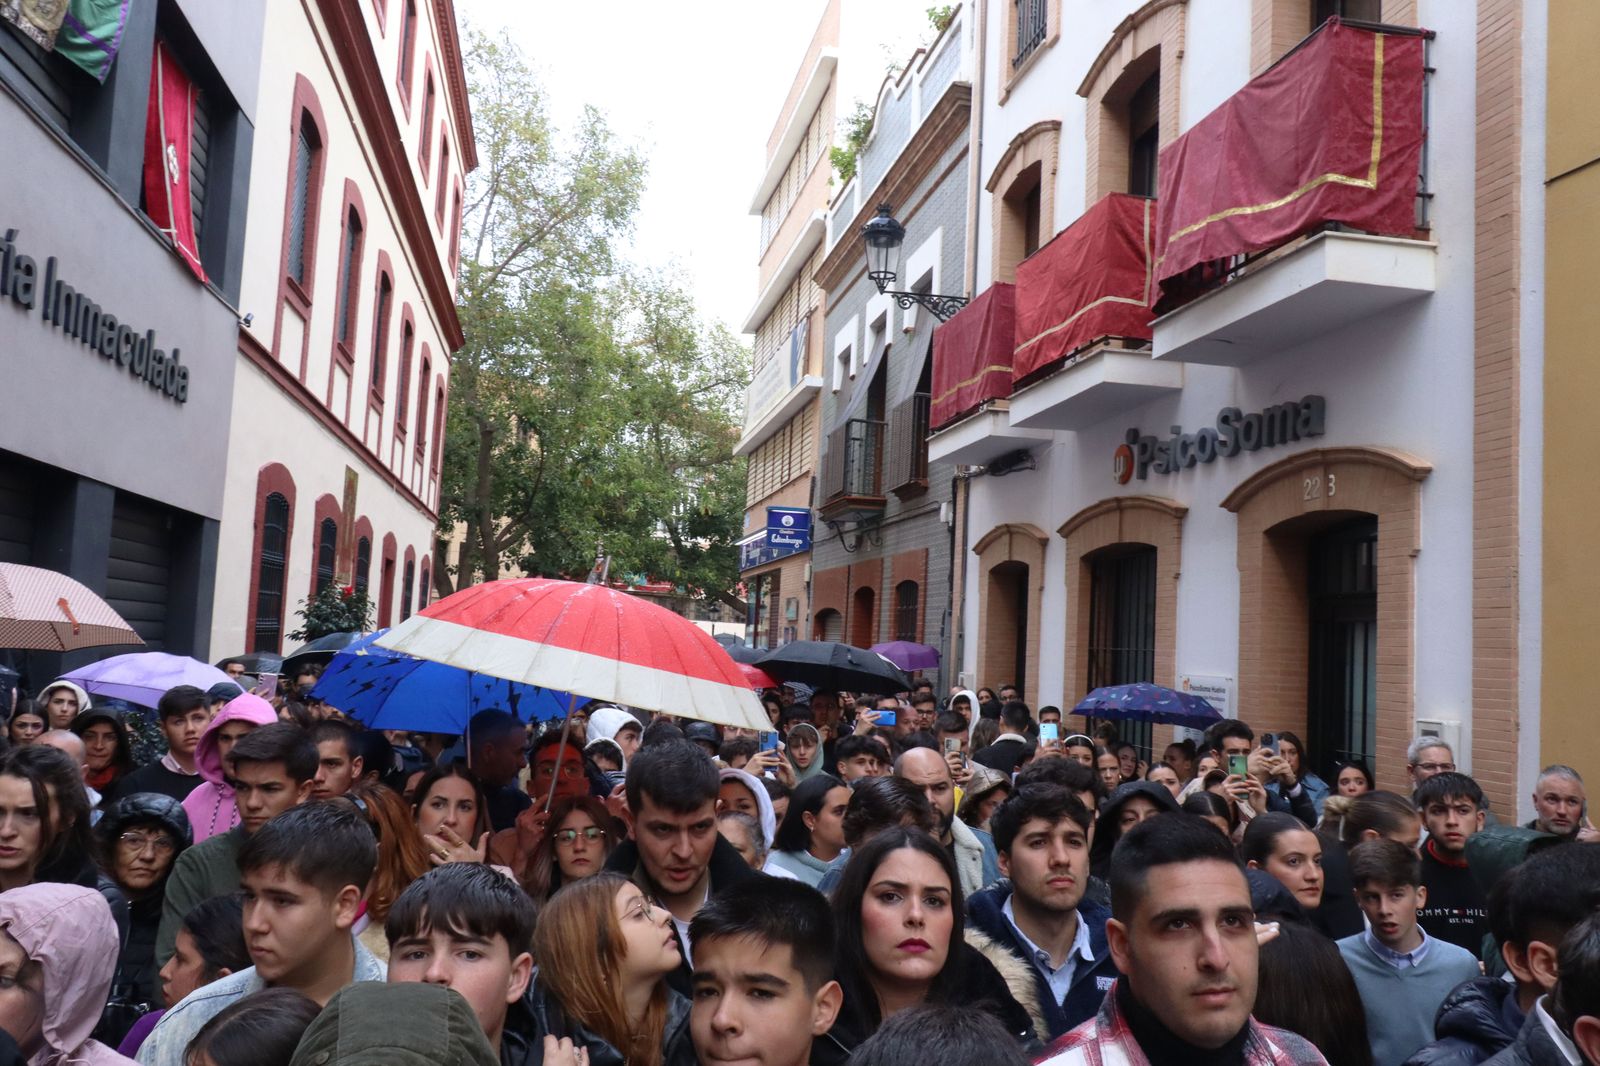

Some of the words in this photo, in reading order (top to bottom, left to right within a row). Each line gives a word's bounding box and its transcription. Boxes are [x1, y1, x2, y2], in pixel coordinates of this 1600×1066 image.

[43, 256, 189, 403] Inmaculada
[1136, 394, 1326, 480] PsicoSoma
[1303, 476, 1320, 500] 22
[1328, 474, 1336, 496] 3
[1416, 908, 1449, 916] OMMY
